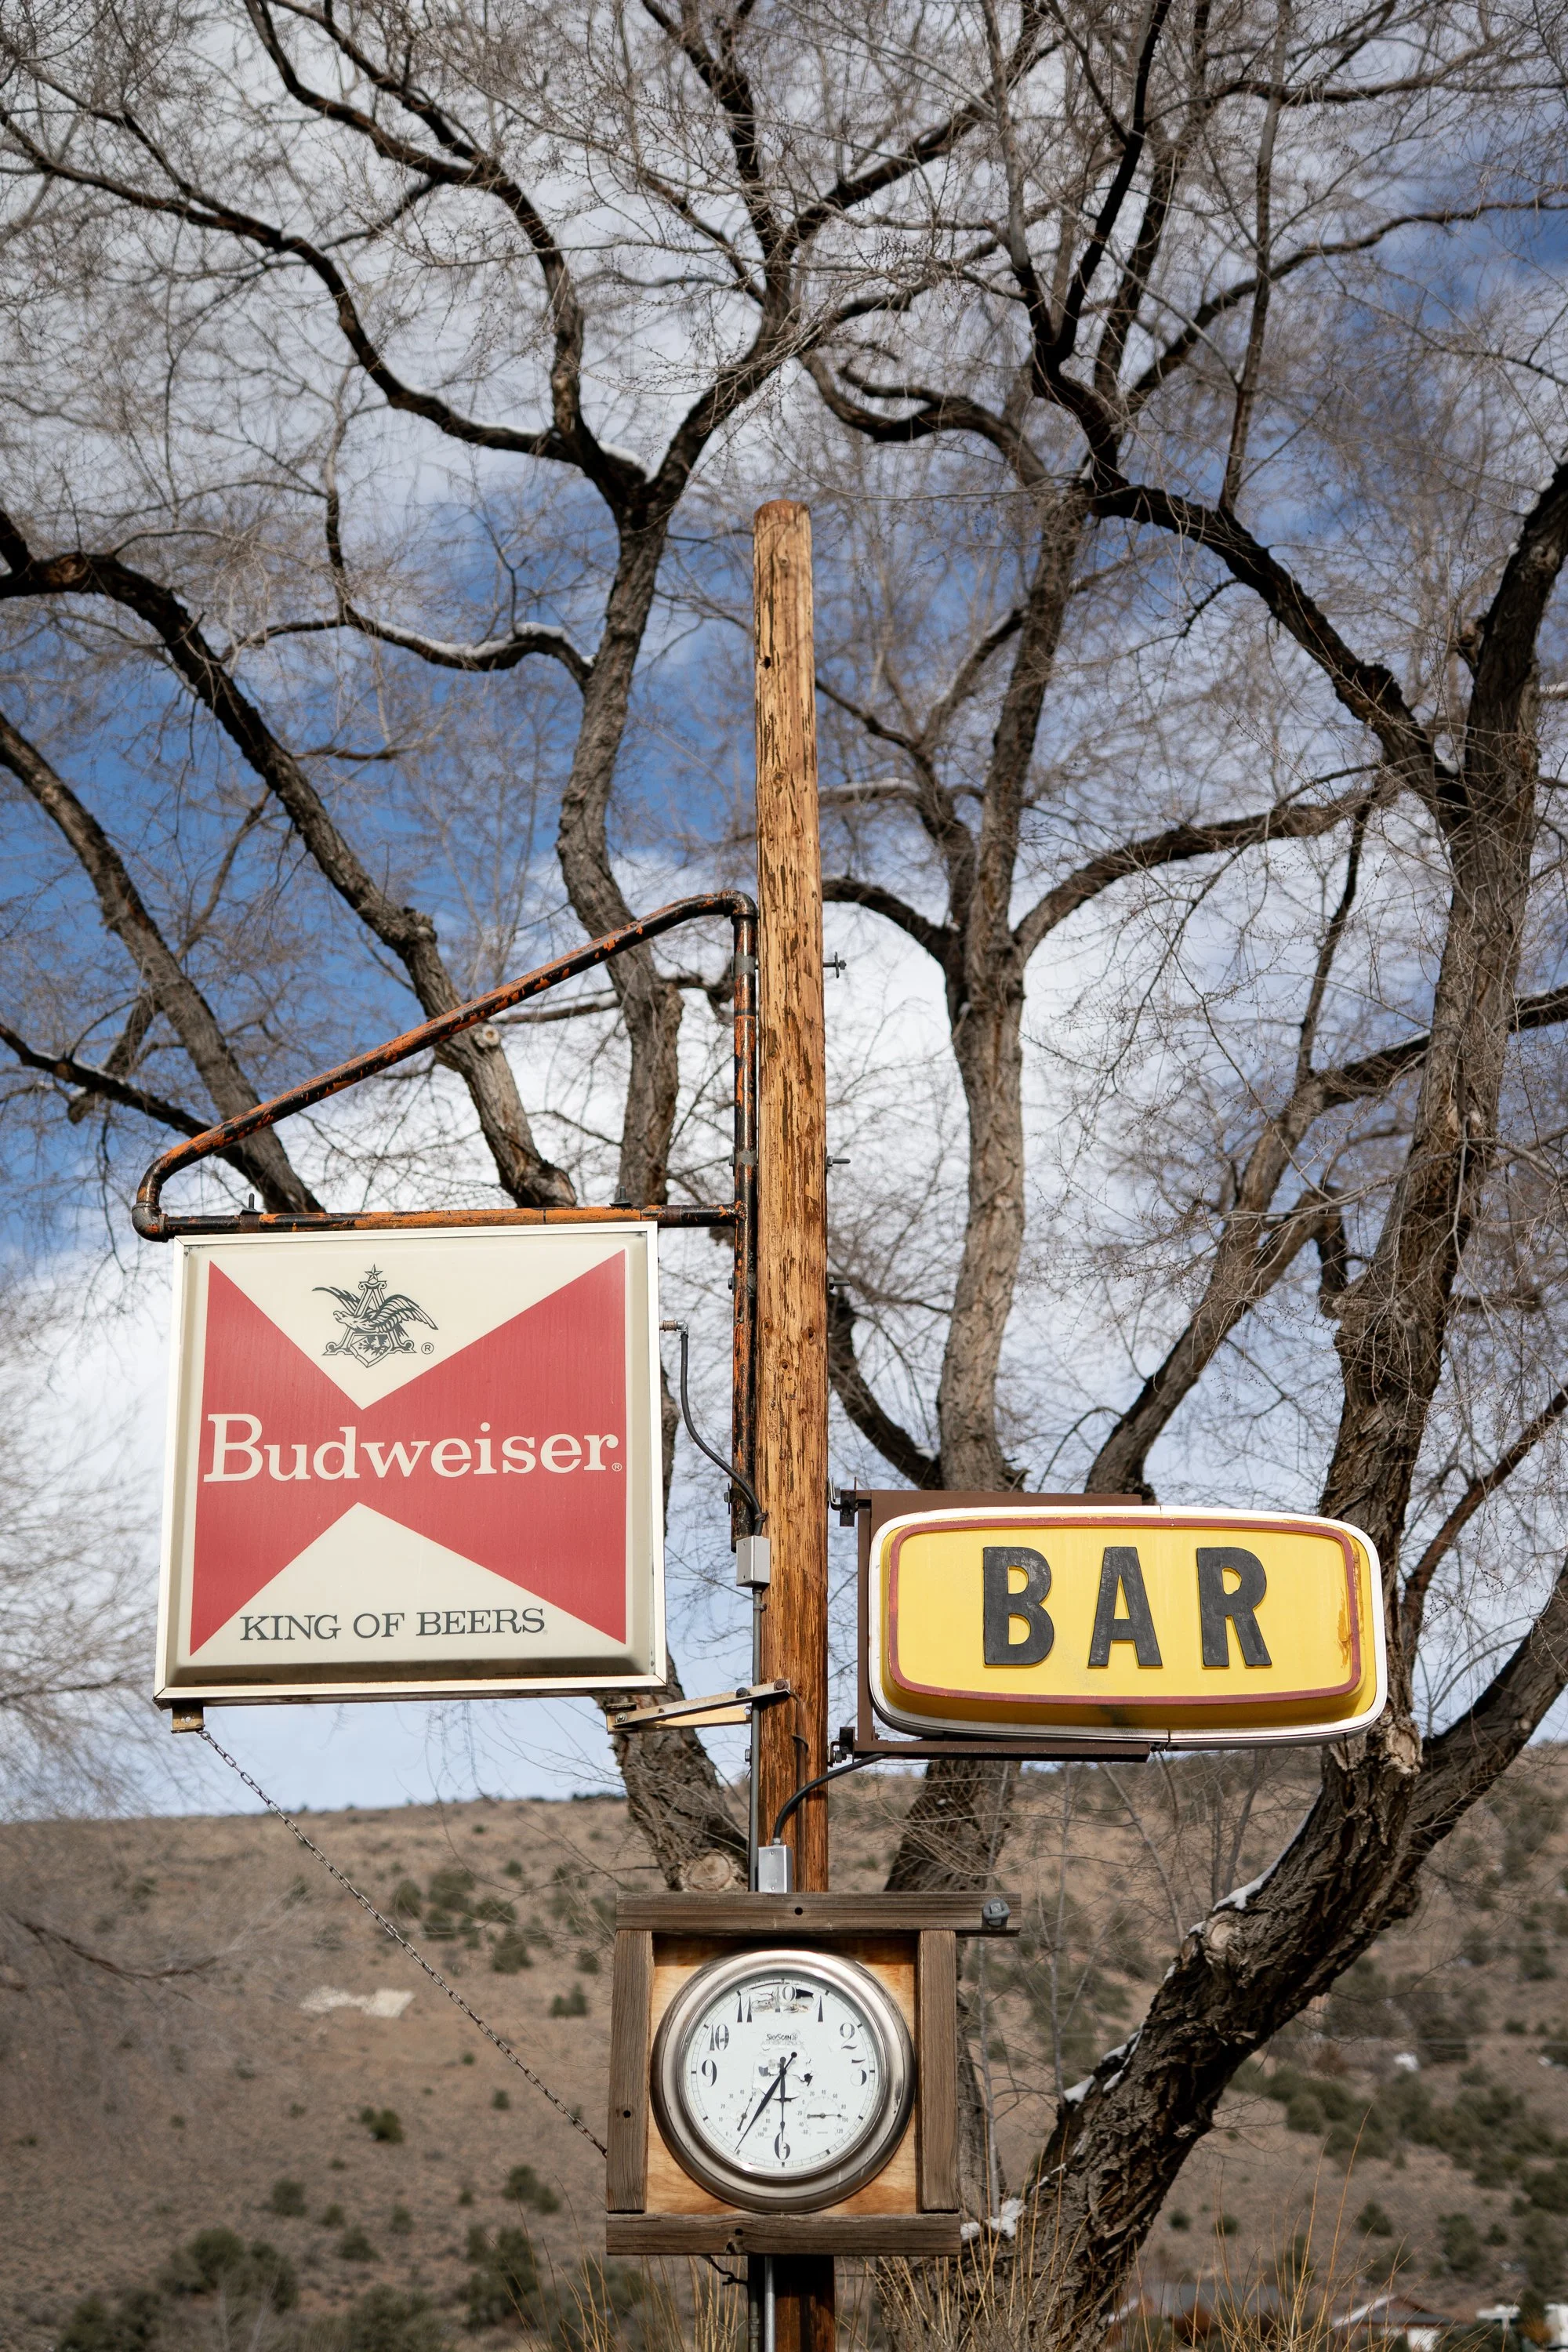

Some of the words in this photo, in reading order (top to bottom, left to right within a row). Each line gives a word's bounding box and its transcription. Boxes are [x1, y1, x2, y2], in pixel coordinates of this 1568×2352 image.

[982, 1546, 1273, 1668] BAR
[239, 1614, 342, 1642] KING
[353, 1612, 405, 1639] OF
[734, 1994, 753, 2023] 11
[815, 1994, 824, 2023] 1
[706, 2024, 730, 2051] 10
[839, 2023, 858, 2050] 2
[701, 2059, 717, 2087] 9
[850, 2059, 867, 2087] 3
[775, 2132, 791, 2161] 6
